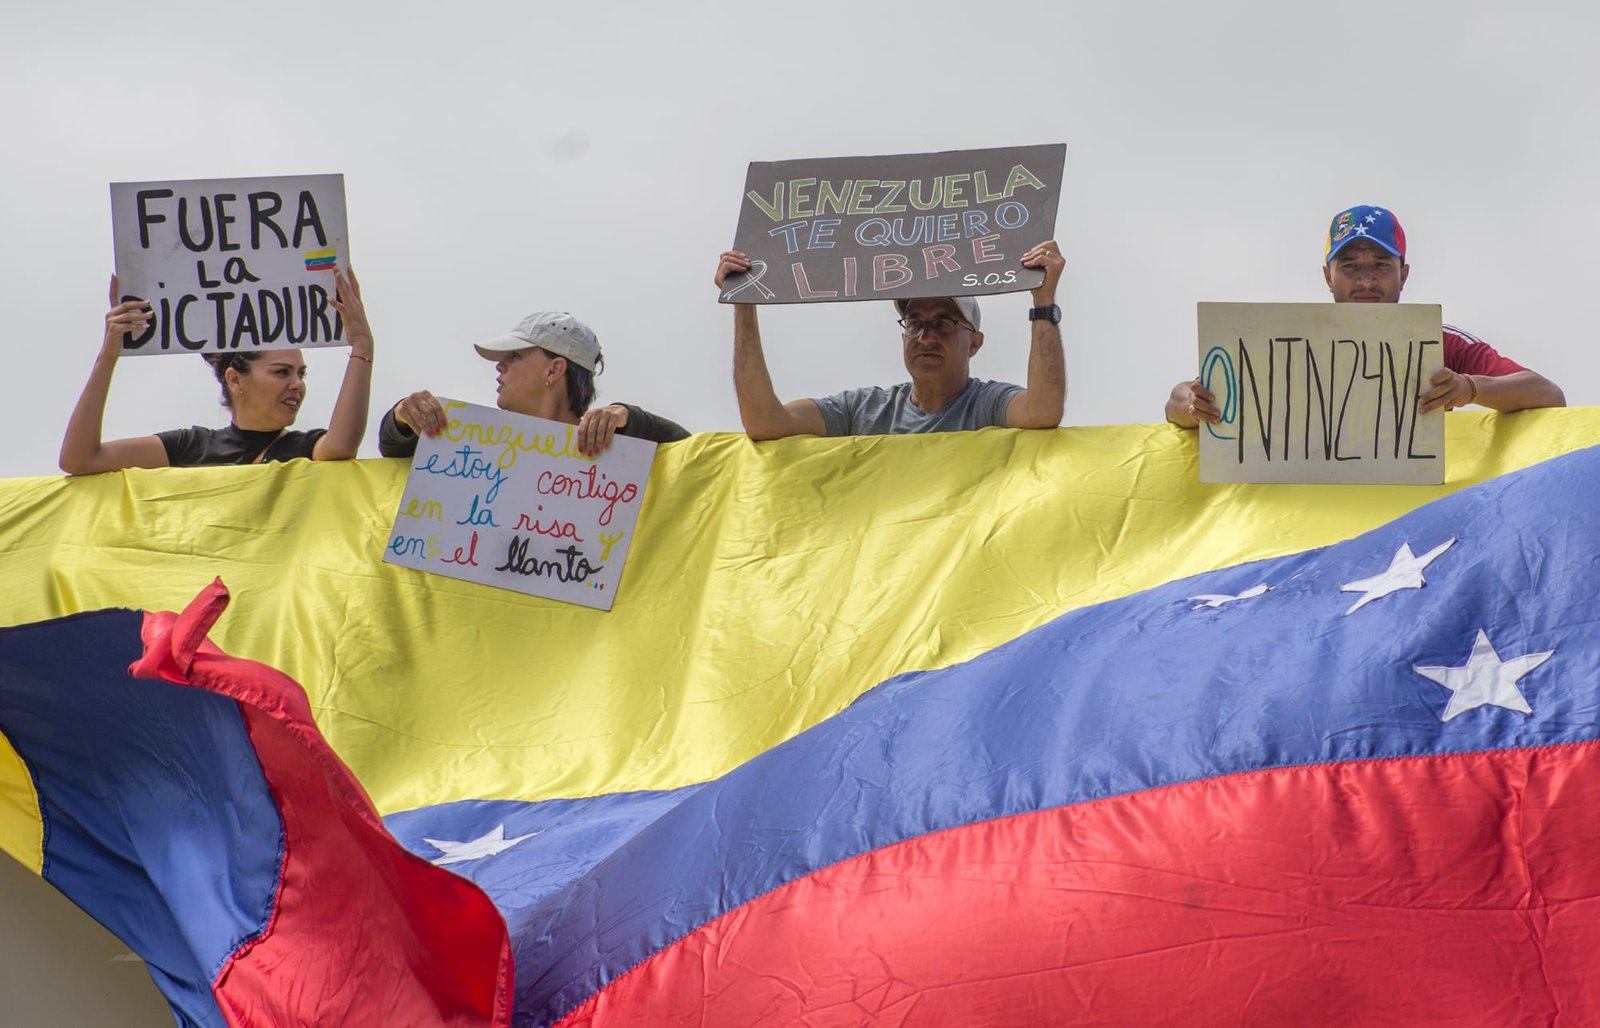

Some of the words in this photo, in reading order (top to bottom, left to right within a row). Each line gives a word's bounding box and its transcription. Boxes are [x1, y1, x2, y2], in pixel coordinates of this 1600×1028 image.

[136, 188, 328, 252] FUERA
[747, 164, 1047, 222] VENEZUELA
[768, 219, 841, 254] TE
[855, 201, 1030, 247] QUIERO
[791, 234, 1005, 300] LIBRE
[415, 445, 508, 504] estoy
[537, 464, 637, 526] contigo
[400, 497, 443, 522] en
[456, 494, 500, 527] la
[512, 504, 584, 542] risa
[388, 535, 426, 559] en
[441, 531, 478, 566] el
